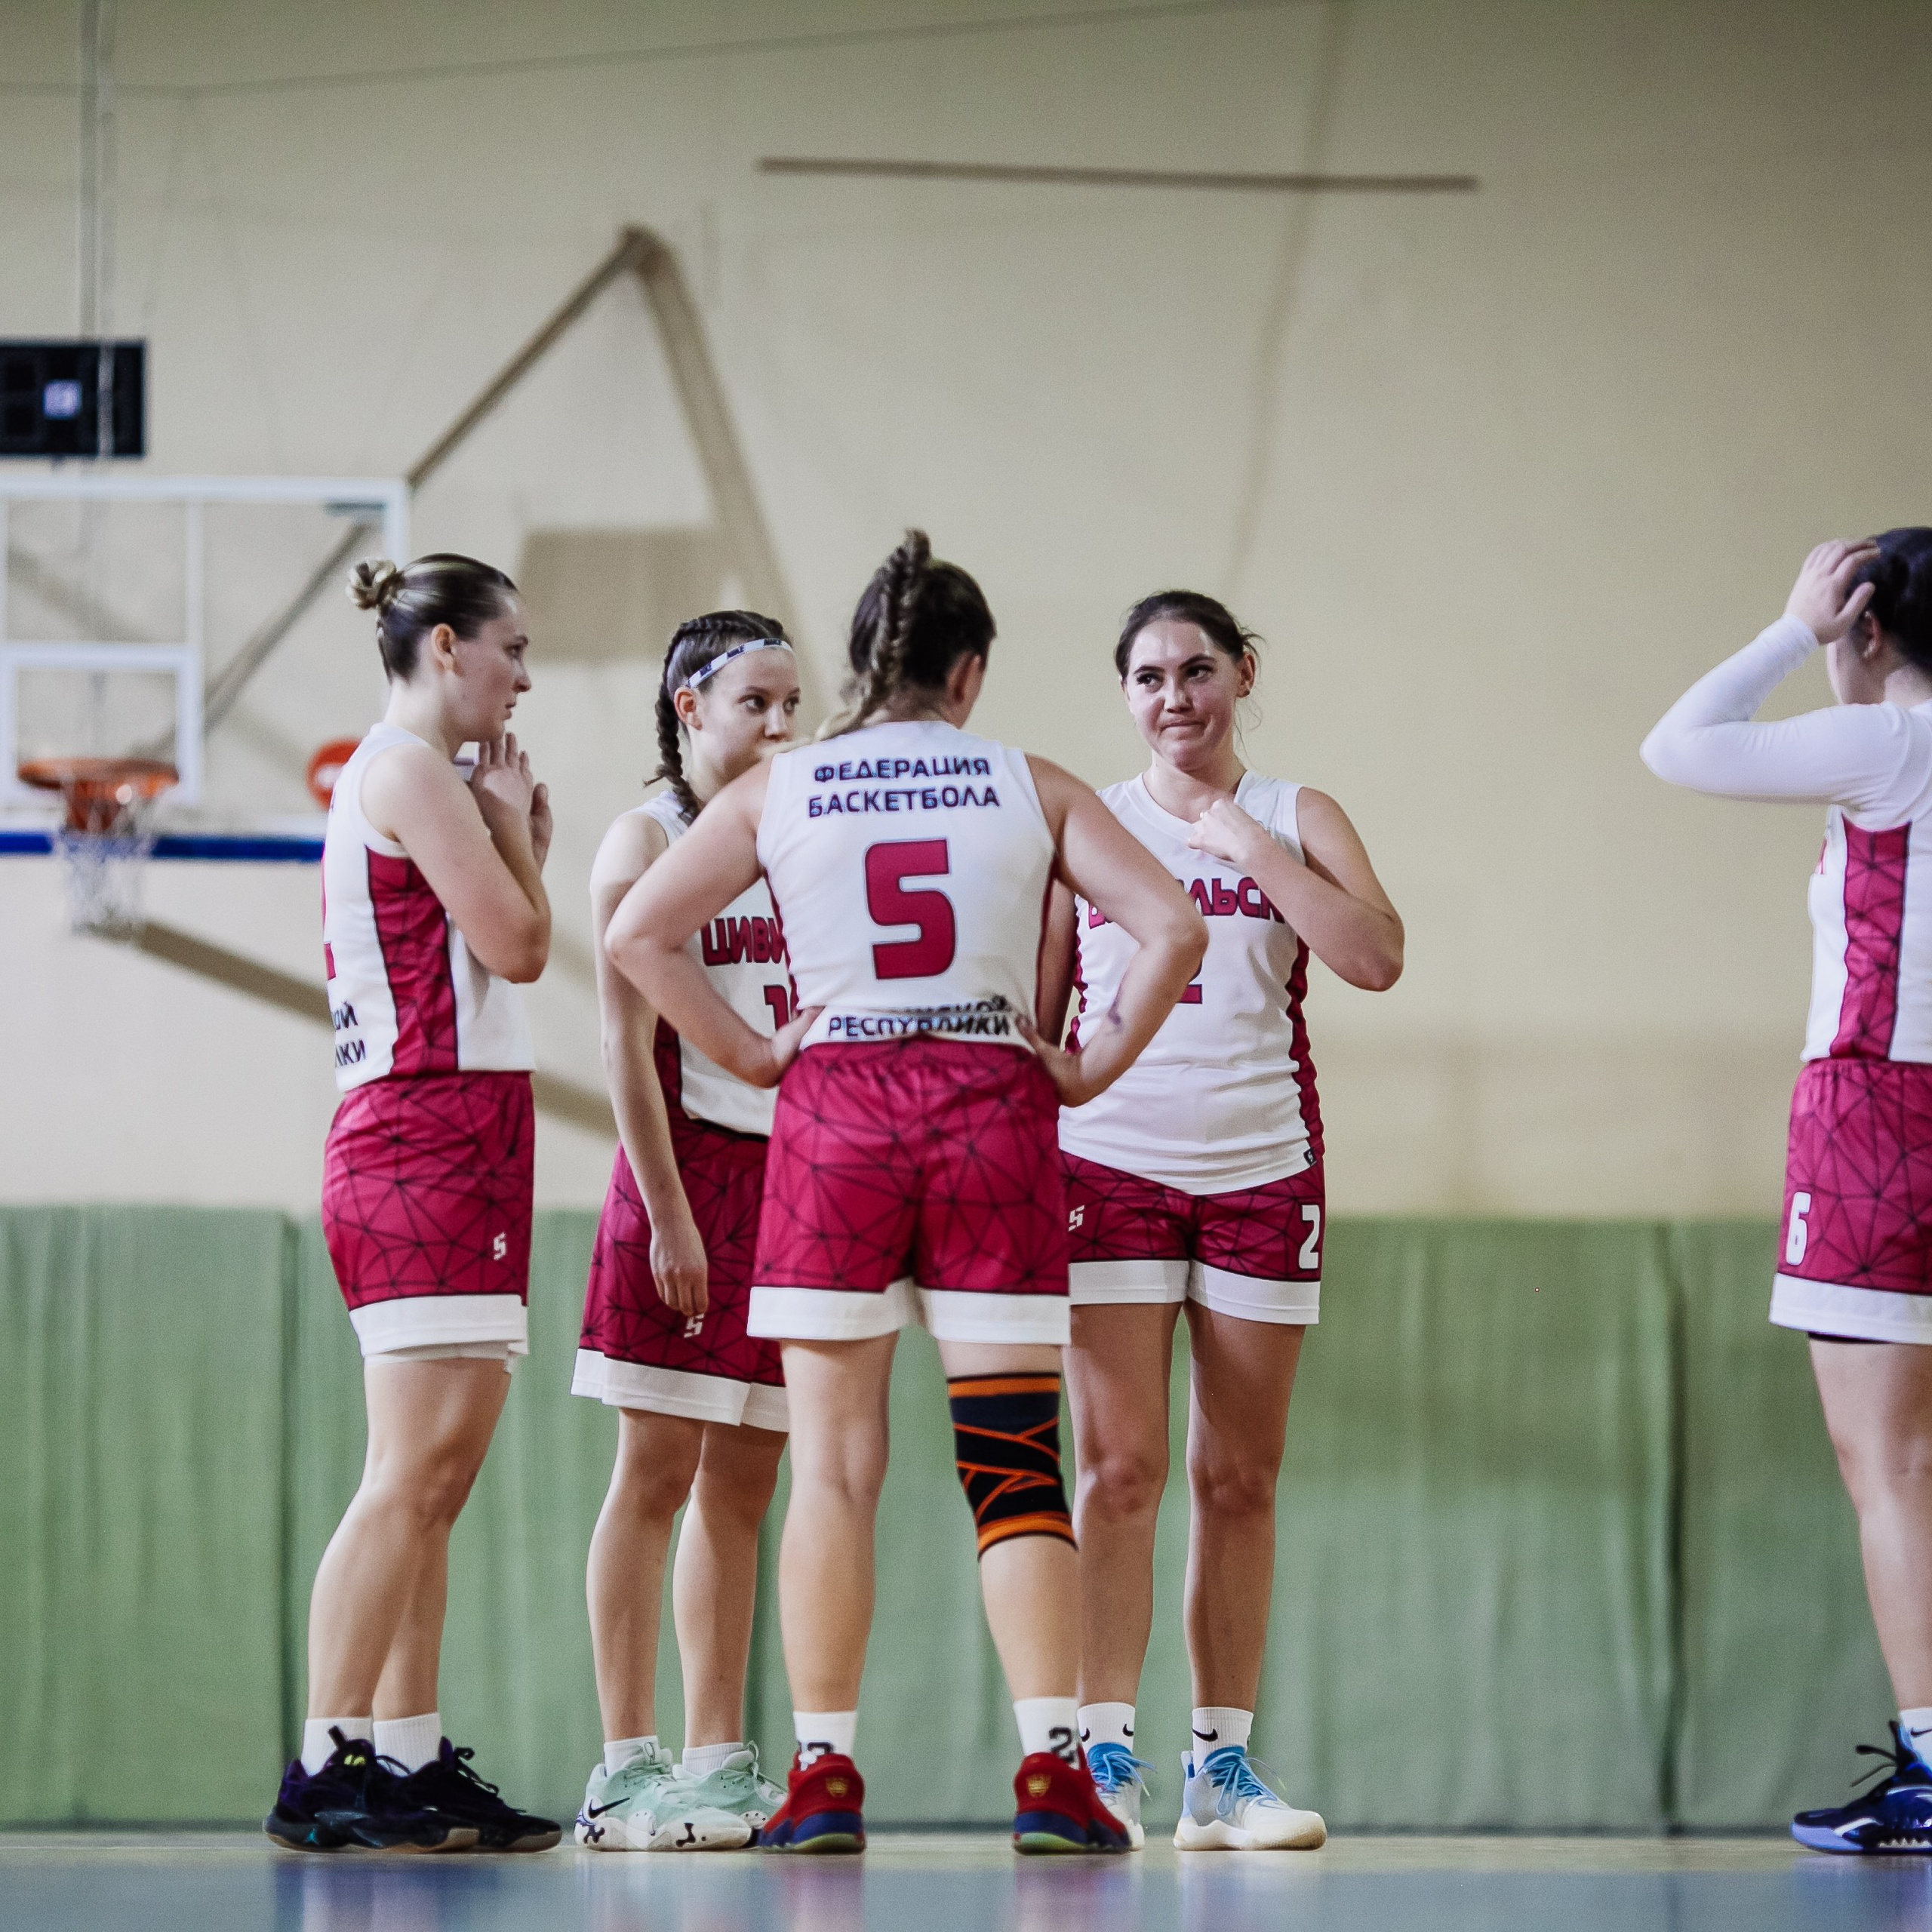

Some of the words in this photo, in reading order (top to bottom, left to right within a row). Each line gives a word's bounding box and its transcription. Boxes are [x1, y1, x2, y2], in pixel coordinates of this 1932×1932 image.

[808, 786, 1000, 818] БАСКЕТБОЛА
[814, 756, 991, 783] ФЕДЕРАЦИЯ
[865, 838, 955, 980] 5
[1298, 1204, 1320, 1269] 2
[1786, 1191, 1811, 1266] 6
